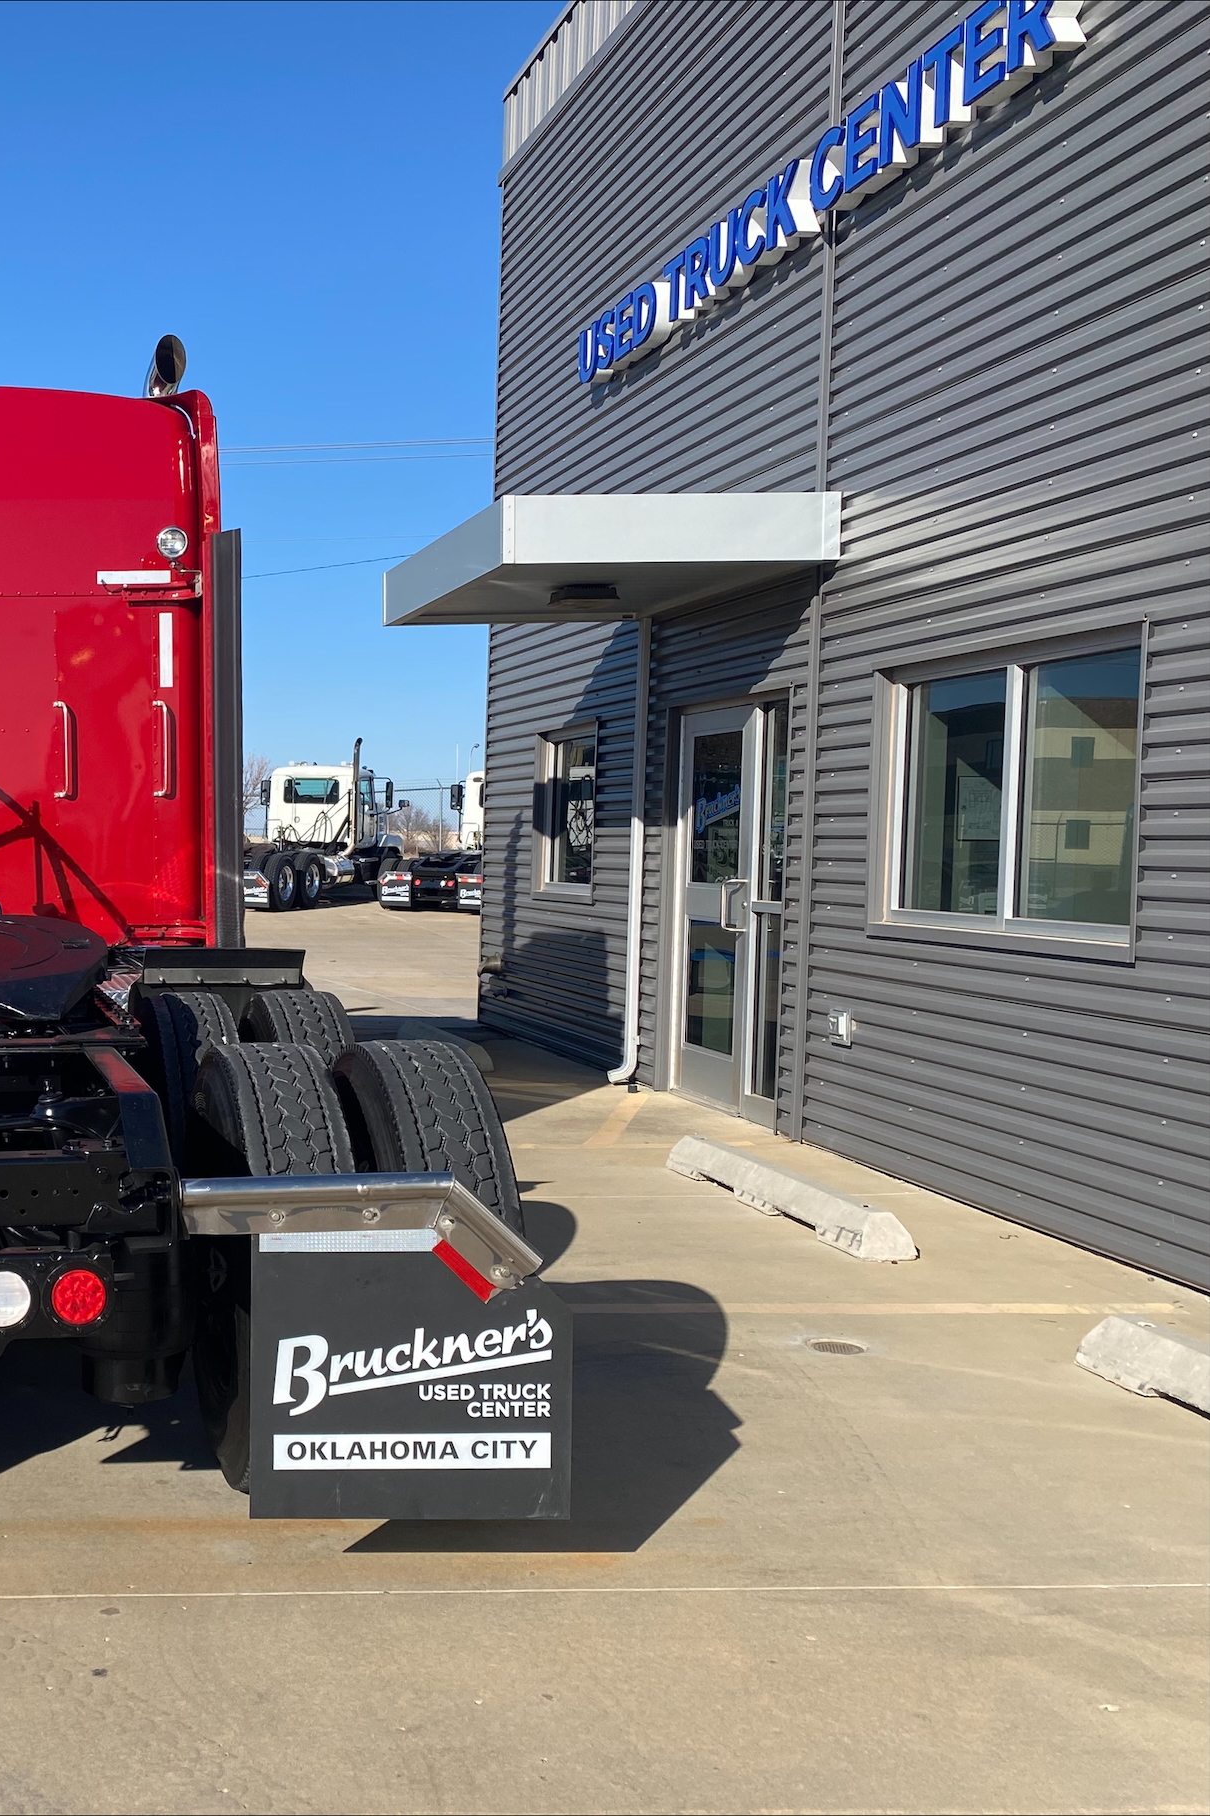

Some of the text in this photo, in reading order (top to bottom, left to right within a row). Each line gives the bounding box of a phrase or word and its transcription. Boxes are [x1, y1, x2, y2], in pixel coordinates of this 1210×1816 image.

[578, 0, 1057, 384] USED TRUCK CENTER
[272, 1308, 553, 1417] Bruckner's
[418, 1383, 552, 1401] USED TRUCK
[466, 1401, 551, 1418] CENTER
[286, 1440, 538, 1461] OKLAHOMA CITY
